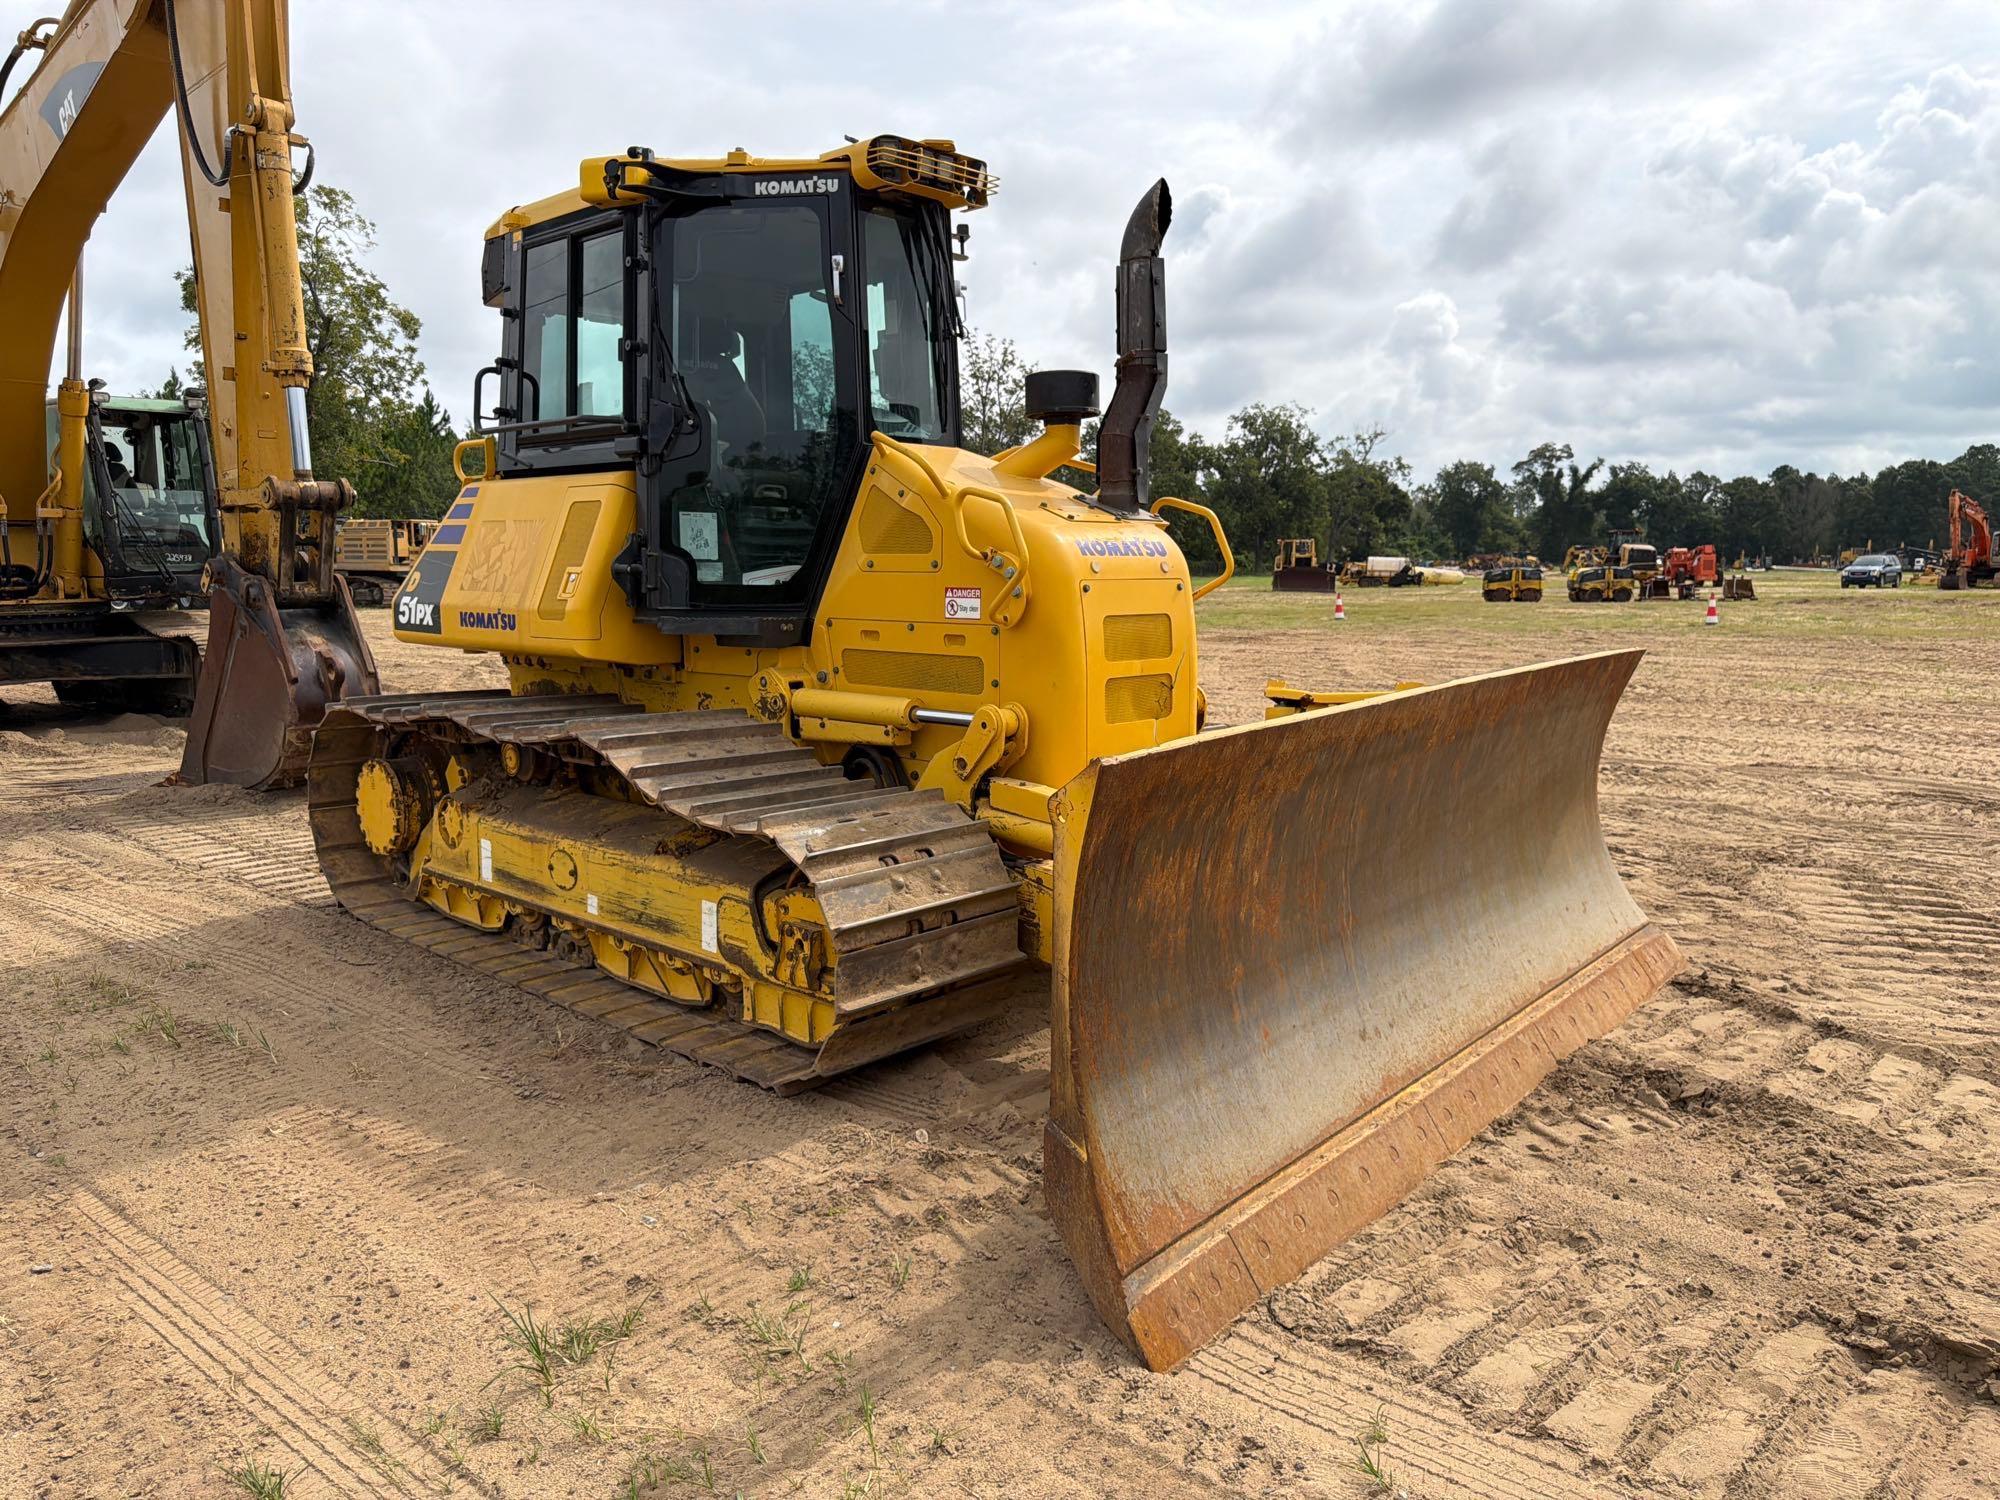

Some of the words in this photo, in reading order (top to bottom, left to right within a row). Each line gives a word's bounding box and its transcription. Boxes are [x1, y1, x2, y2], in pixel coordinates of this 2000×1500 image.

[59, 88, 77, 136] CAT
[755, 175, 839, 195] KOMATSU
[1075, 537, 1167, 557] KOMATSU
[953, 589, 981, 598] DANGER
[460, 608, 516, 631] KOMATSU
